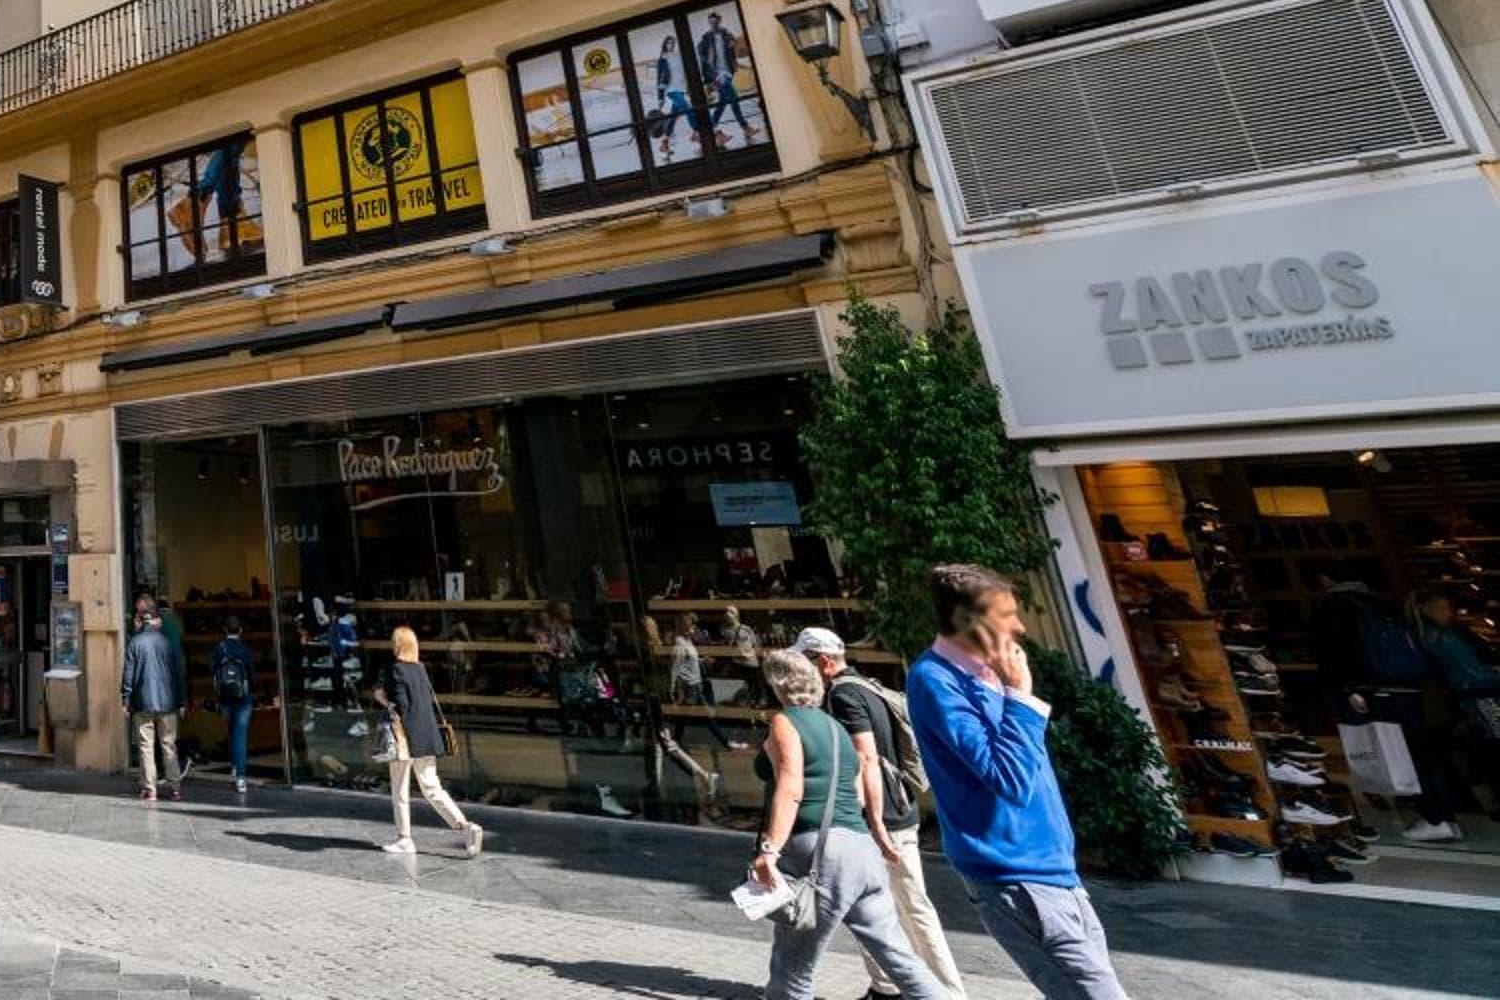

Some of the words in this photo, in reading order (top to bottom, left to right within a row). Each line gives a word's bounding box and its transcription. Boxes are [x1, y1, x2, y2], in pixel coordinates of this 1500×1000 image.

[1089, 250, 1380, 335] ZANKOS
[1246, 315, 1396, 351] ZAPATERÍAS
[338, 439, 381, 482] Paco
